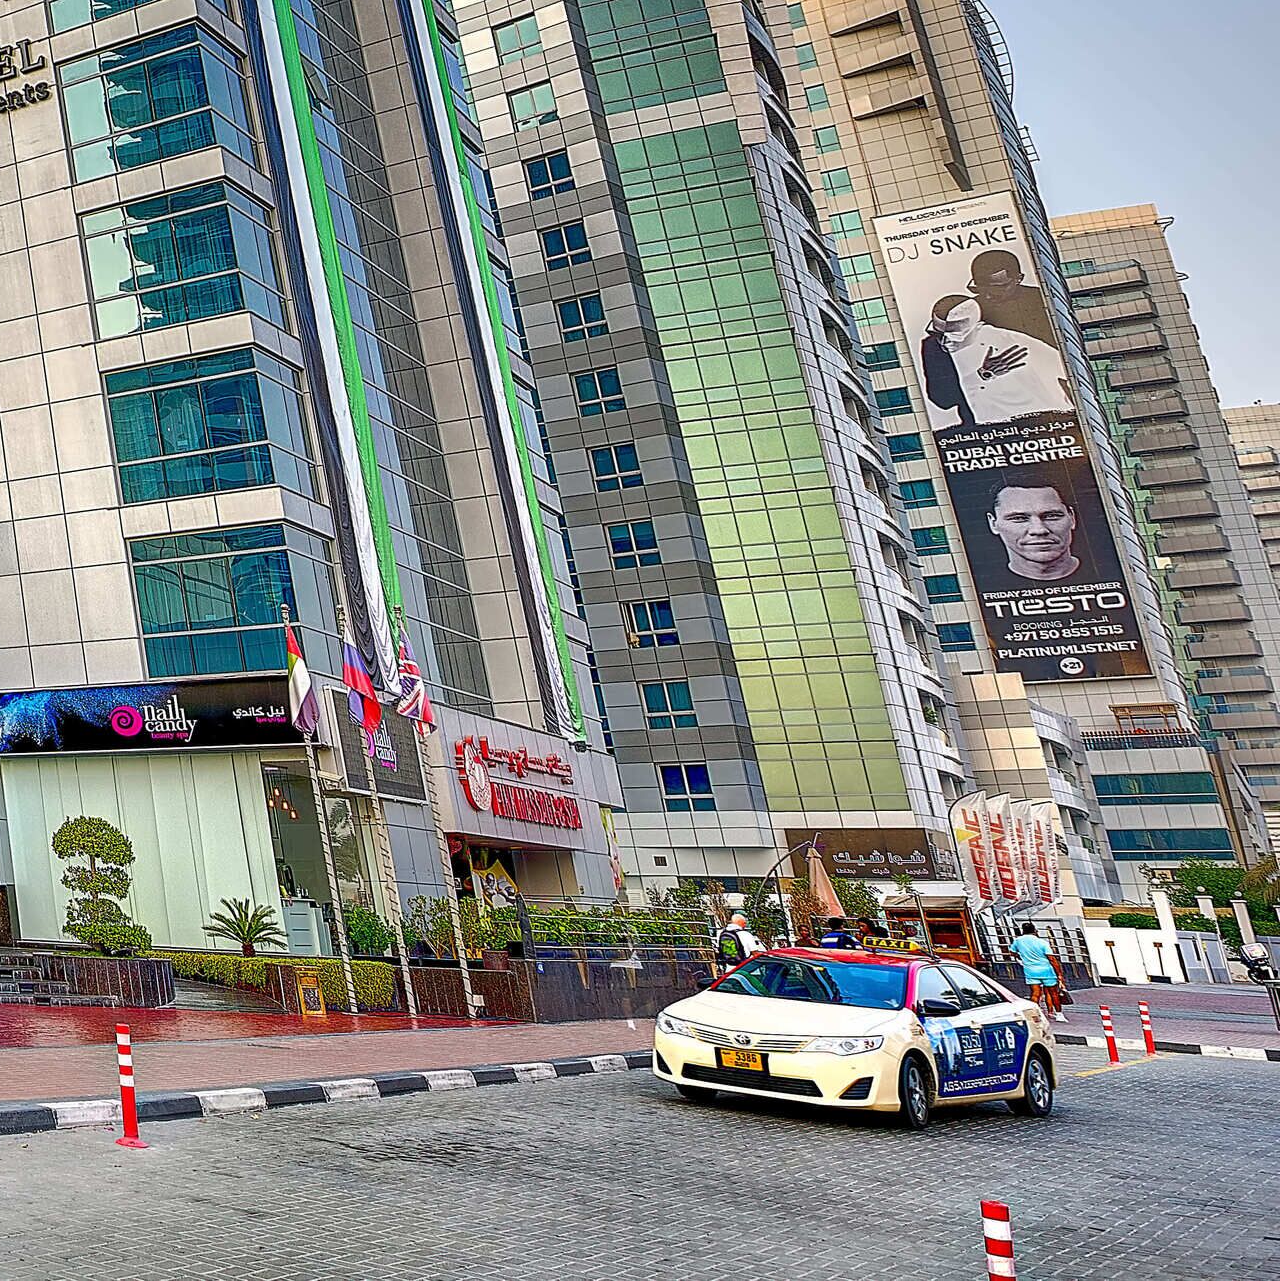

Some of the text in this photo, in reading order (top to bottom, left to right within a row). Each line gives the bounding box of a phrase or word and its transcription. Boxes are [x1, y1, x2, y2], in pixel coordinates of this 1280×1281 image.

[884, 213, 1010, 243] THURSDAY 1ST OF DECEMBER
[887, 224, 1017, 264] DJ SNAKE
[1020, 424, 1046, 438] دبي
[1048, 420, 1076, 433] مركز
[945, 435, 1076, 462] DUBAI WORLD
[944, 445, 1084, 474] TRADE CENTRE
[982, 581, 1122, 601] FRIDAY 2ND OF DECEMBER
[1003, 625, 1124, 642] +971 50 855 1515
[1012, 620, 1063, 632] BOOKING
[997, 640, 1139, 659] PLATINUMLIST.NET
[1061, 661, 1082, 671] +21
[142, 694, 181, 722] nail
[232, 705, 286, 720] نيل كاندي
[144, 708, 198, 743] candy
[175, 731, 189, 739] spa
[961, 807, 995, 902] MOSAIC
[988, 810, 1019, 902] MOSAIC
[872, 938, 905, 949] TAXI
